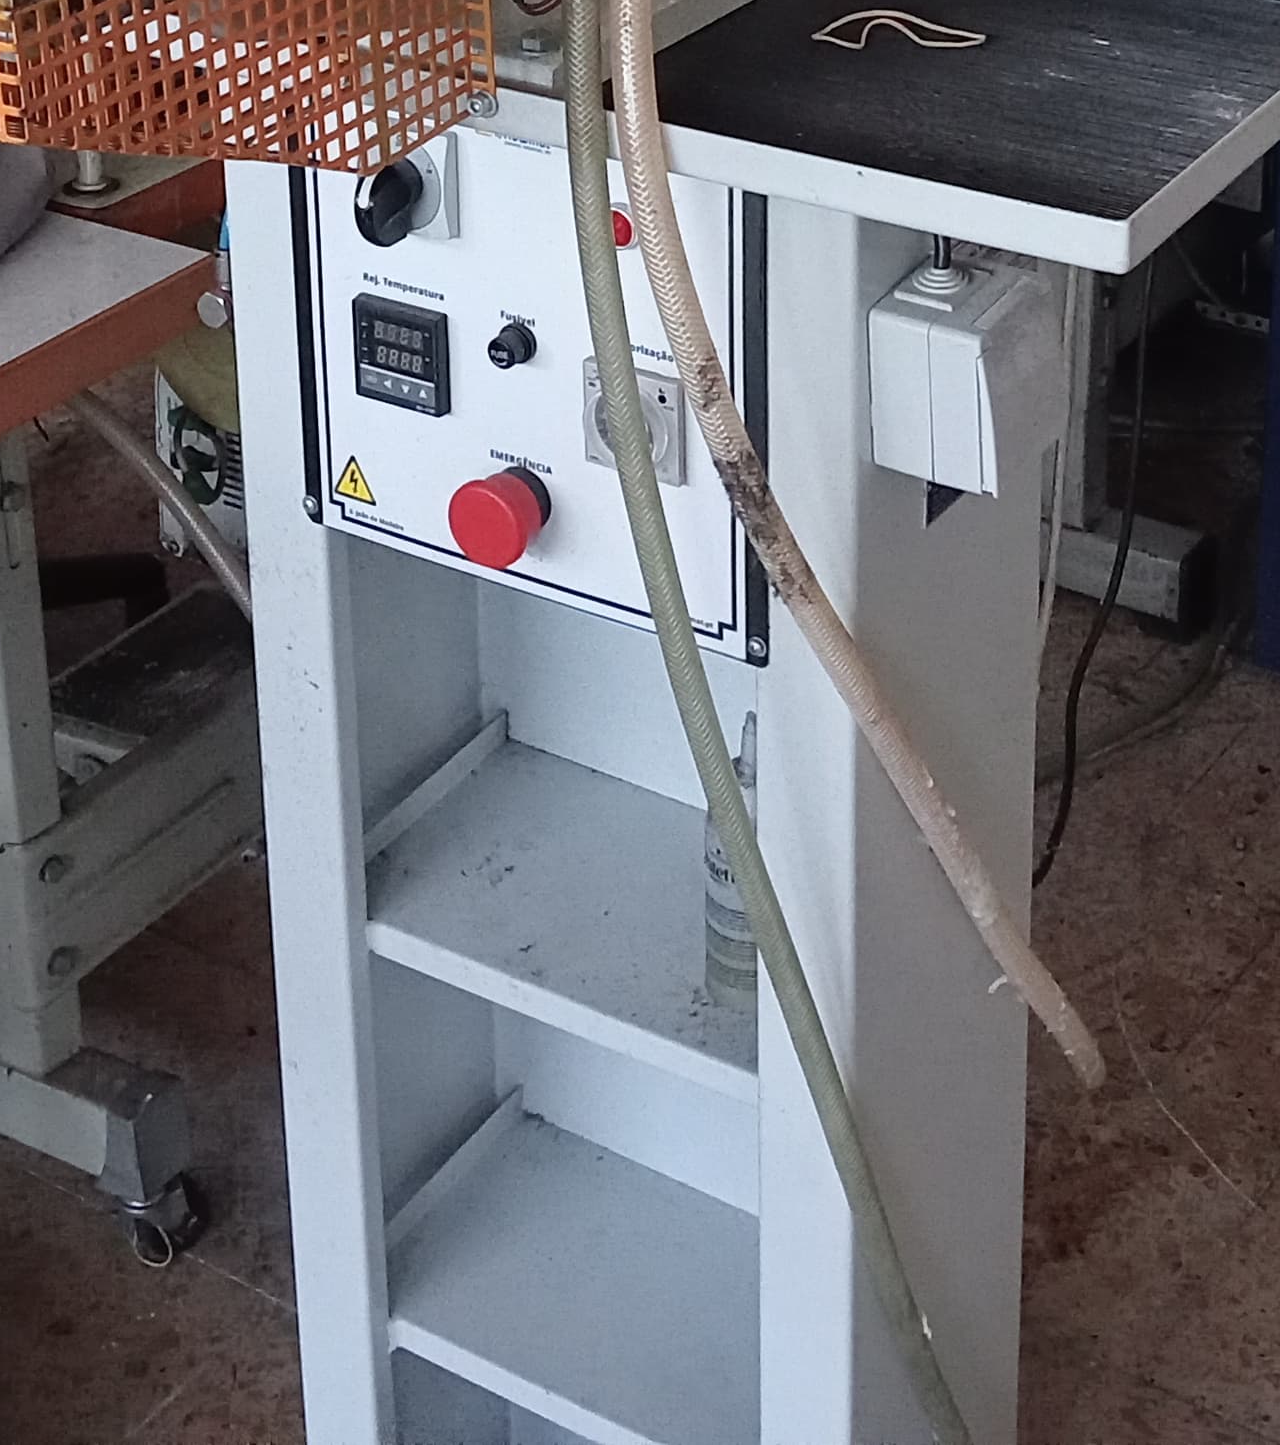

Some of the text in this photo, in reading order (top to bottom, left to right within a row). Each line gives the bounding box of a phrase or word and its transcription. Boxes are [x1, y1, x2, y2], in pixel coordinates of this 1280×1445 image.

[383, 277, 445, 302] Temperatura
[631, 343, 674, 362] orização
[489, 448, 553, 475] EMERGÊNCIA
